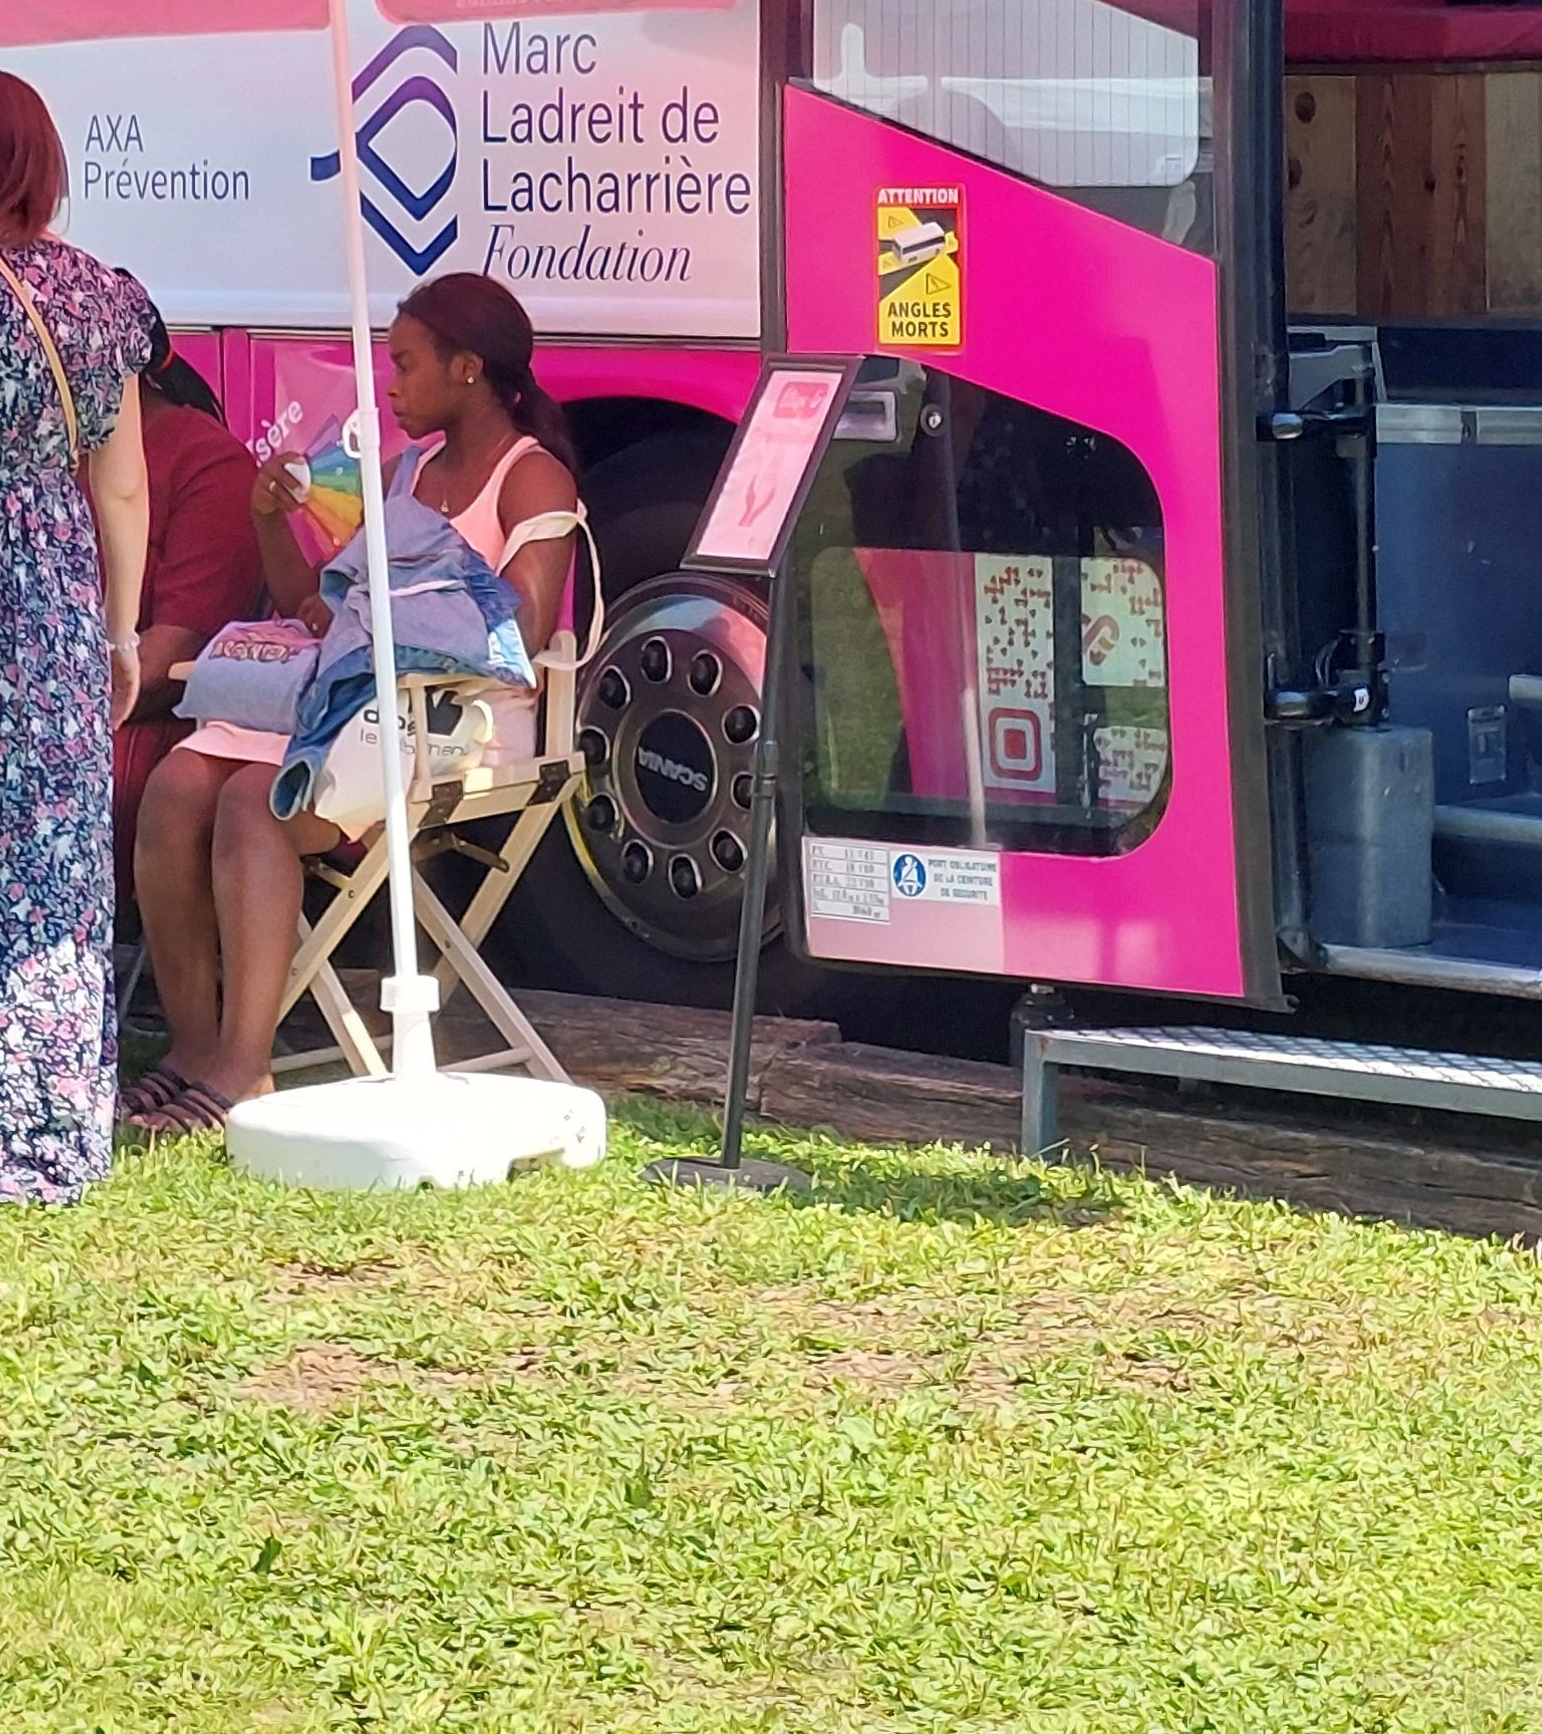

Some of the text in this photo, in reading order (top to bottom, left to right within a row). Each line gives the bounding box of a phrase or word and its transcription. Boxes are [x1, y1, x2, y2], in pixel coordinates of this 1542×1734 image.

[482, 22, 598, 75] Marc
[84, 113, 145, 154] AXA
[482, 86, 721, 146] Ladreit de
[84, 156, 251, 203] Prévention
[482, 158, 752, 216] Lacharrière
[878, 187, 958, 204] ATTENTION
[479, 224, 692, 284] Fondation
[888, 301, 952, 319] ANGLES
[891, 321, 949, 338] MORTS
[638, 746, 709, 793] SCANIA
